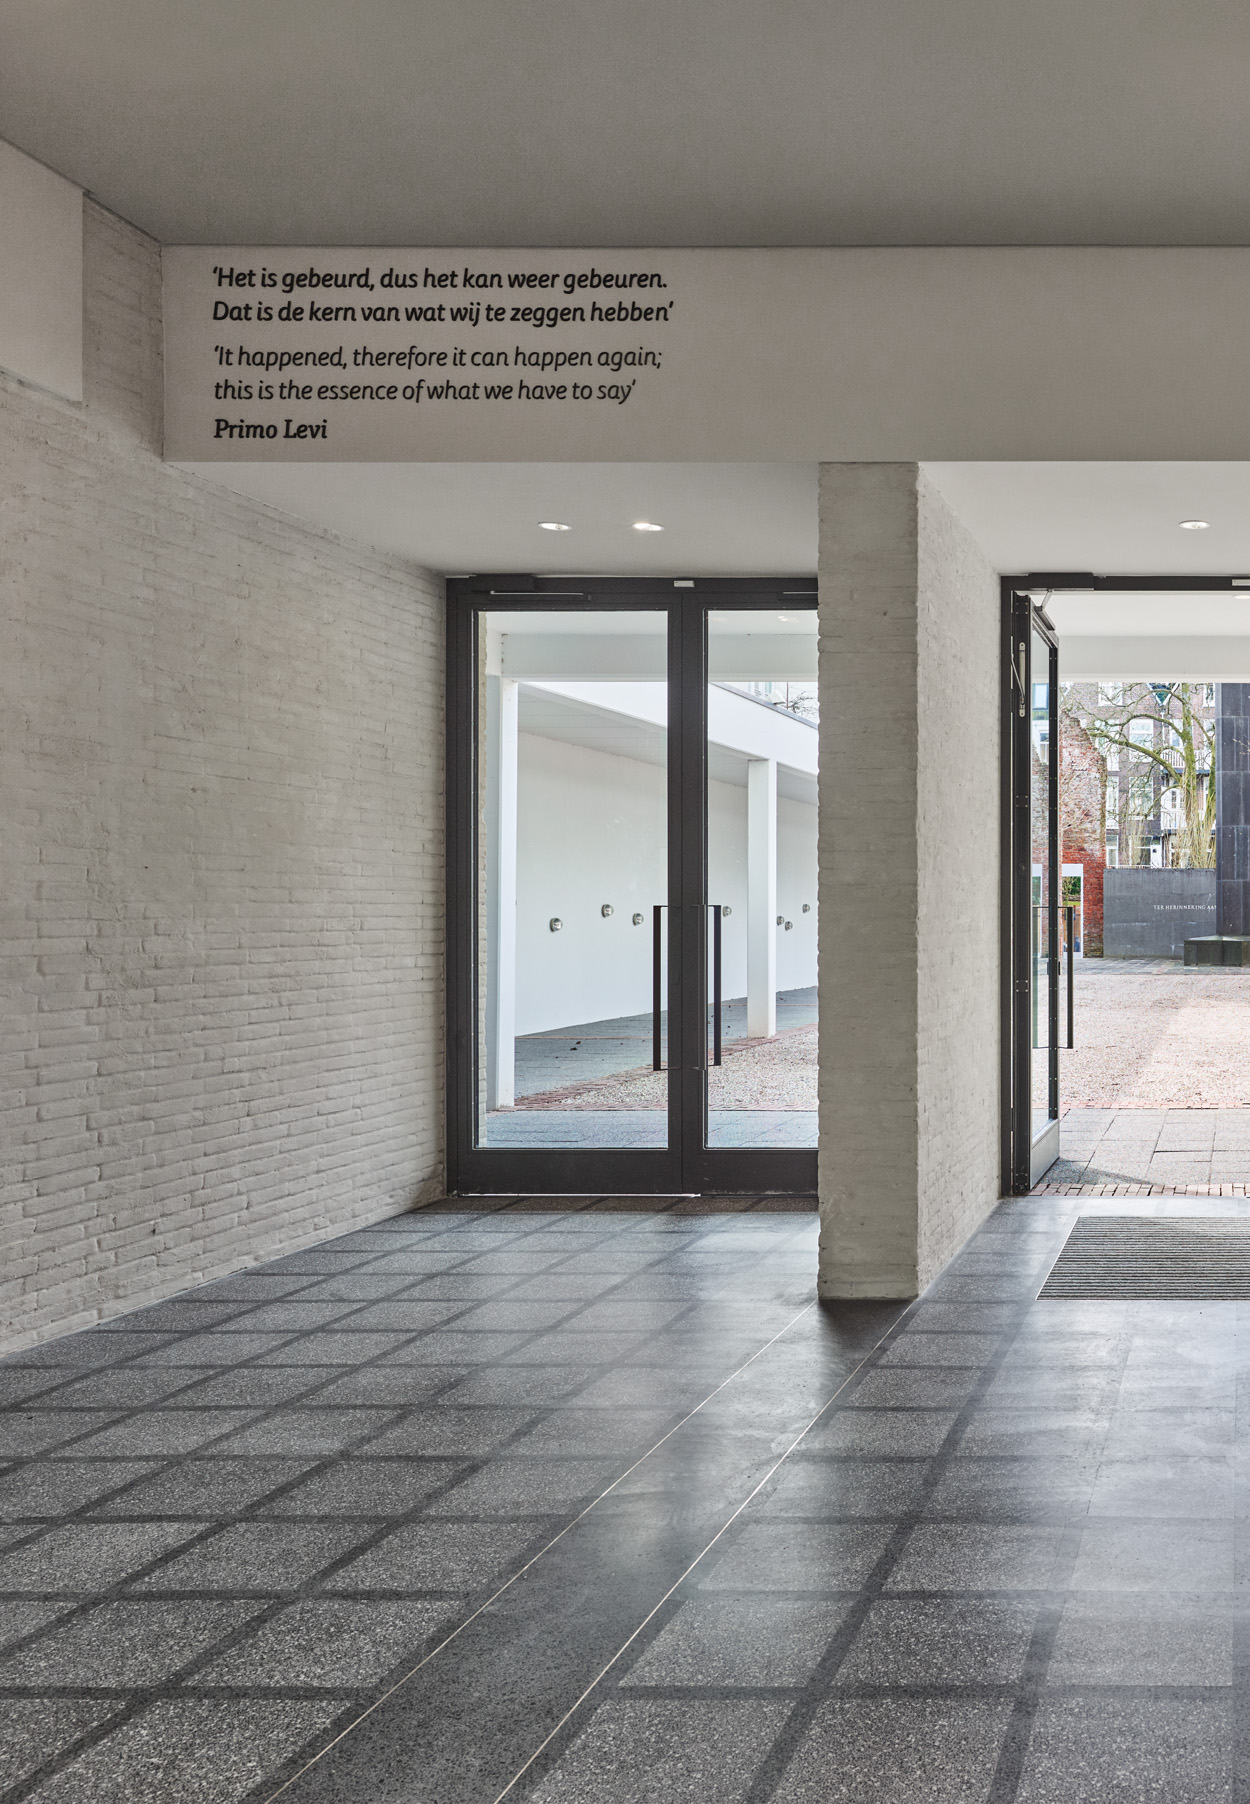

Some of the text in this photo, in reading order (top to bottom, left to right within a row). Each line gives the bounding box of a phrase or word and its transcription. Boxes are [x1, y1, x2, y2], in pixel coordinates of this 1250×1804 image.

[260, 267, 277, 287] is
[281, 266, 374, 293] gebeurd,
[379, 267, 418, 288] dus
[422, 267, 458, 288] het
[462, 267, 503, 288] kan
[507, 273, 560, 288] weer
[562, 267, 667, 294] gebeuren.
[212, 300, 252, 321] Dat
[255, 300, 273, 321] is
[277, 300, 304, 321] de
[308, 300, 357, 321] kern
[360, 306, 400, 321] van
[404, 303, 446, 321] wat
[449, 301, 480, 327] wij
[484, 303, 506, 321] te
[509, 306, 586, 328] zeggen
[237, 345, 347, 370] happened,
[352, 345, 447, 370] therefore
[452, 346, 467, 366] it
[470, 351, 509, 366] can
[513, 345, 592, 371] happen
[596, 346, 661, 372] again;
[213, 378, 253, 400] this
[257, 379, 273, 400] is
[278, 378, 313, 400] the
[316, 384, 398, 400] essence
[401, 378, 426, 403] of
[426, 378, 480, 400] what
[483, 384, 513, 400] we
[517, 378, 567, 400] have
[571, 381, 592, 400] to
[213, 418, 327, 439] Primo Levi
